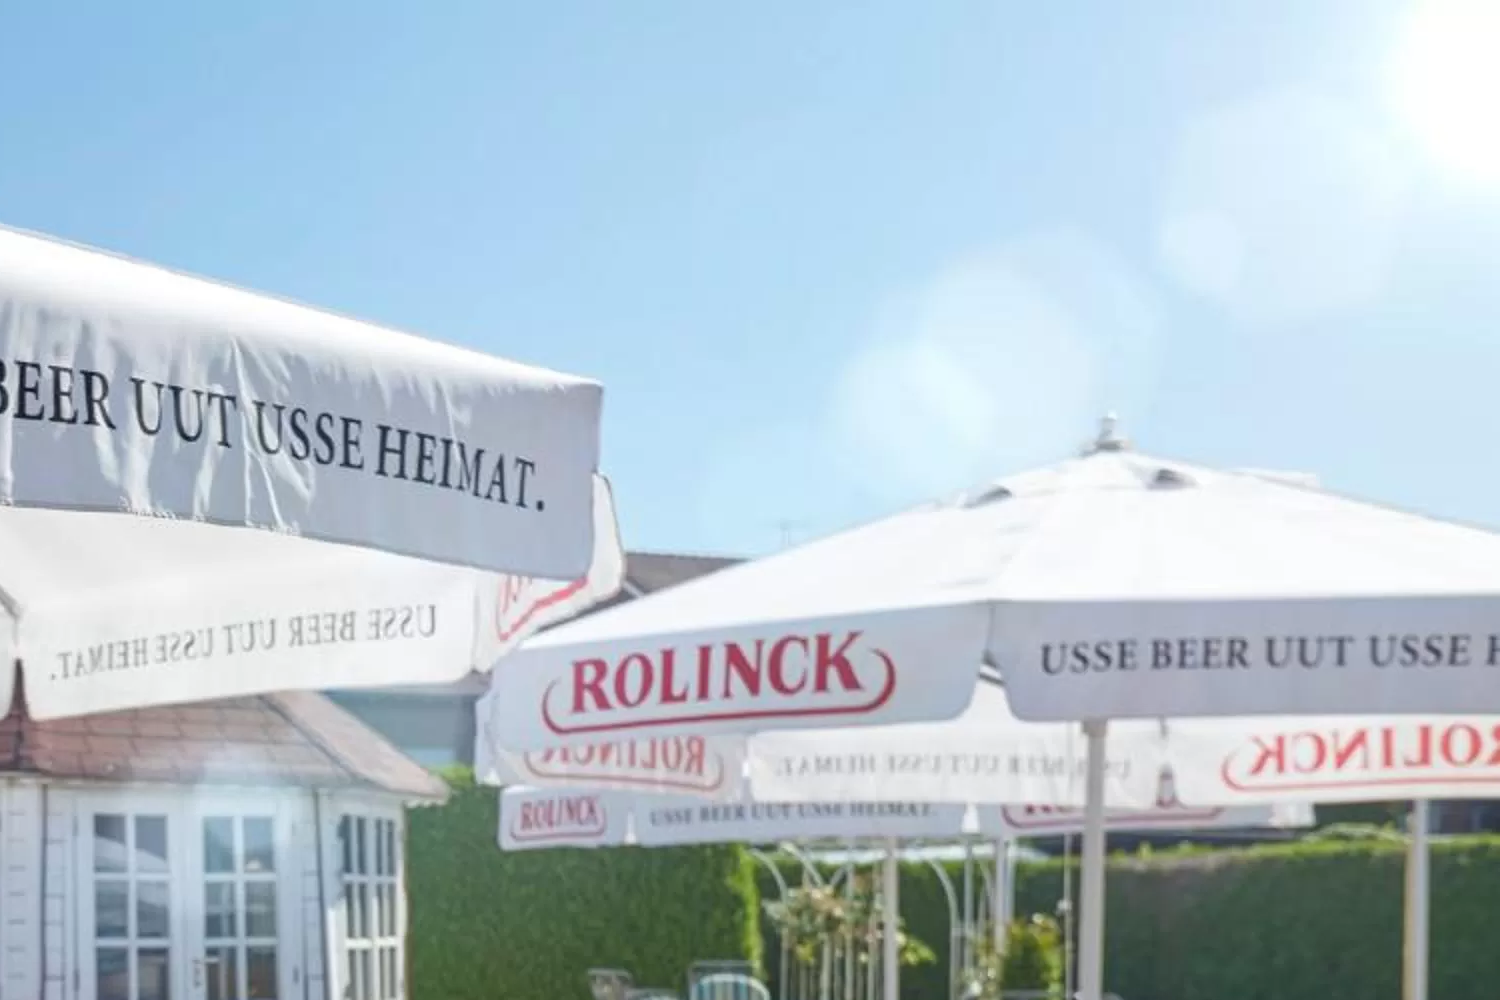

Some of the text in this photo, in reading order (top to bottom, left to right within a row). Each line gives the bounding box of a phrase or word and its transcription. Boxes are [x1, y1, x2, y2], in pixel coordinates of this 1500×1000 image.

[128, 377, 239, 449] UUT
[253, 401, 365, 470] USSE
[375, 424, 547, 512] HEIMAT.
[568, 630, 867, 715] ROLINCK
[1039, 638, 1139, 677] USSE
[1149, 636, 1251, 672] BEER
[1263, 634, 1355, 669] UUT
[1369, 633, 1473, 669] USSE
